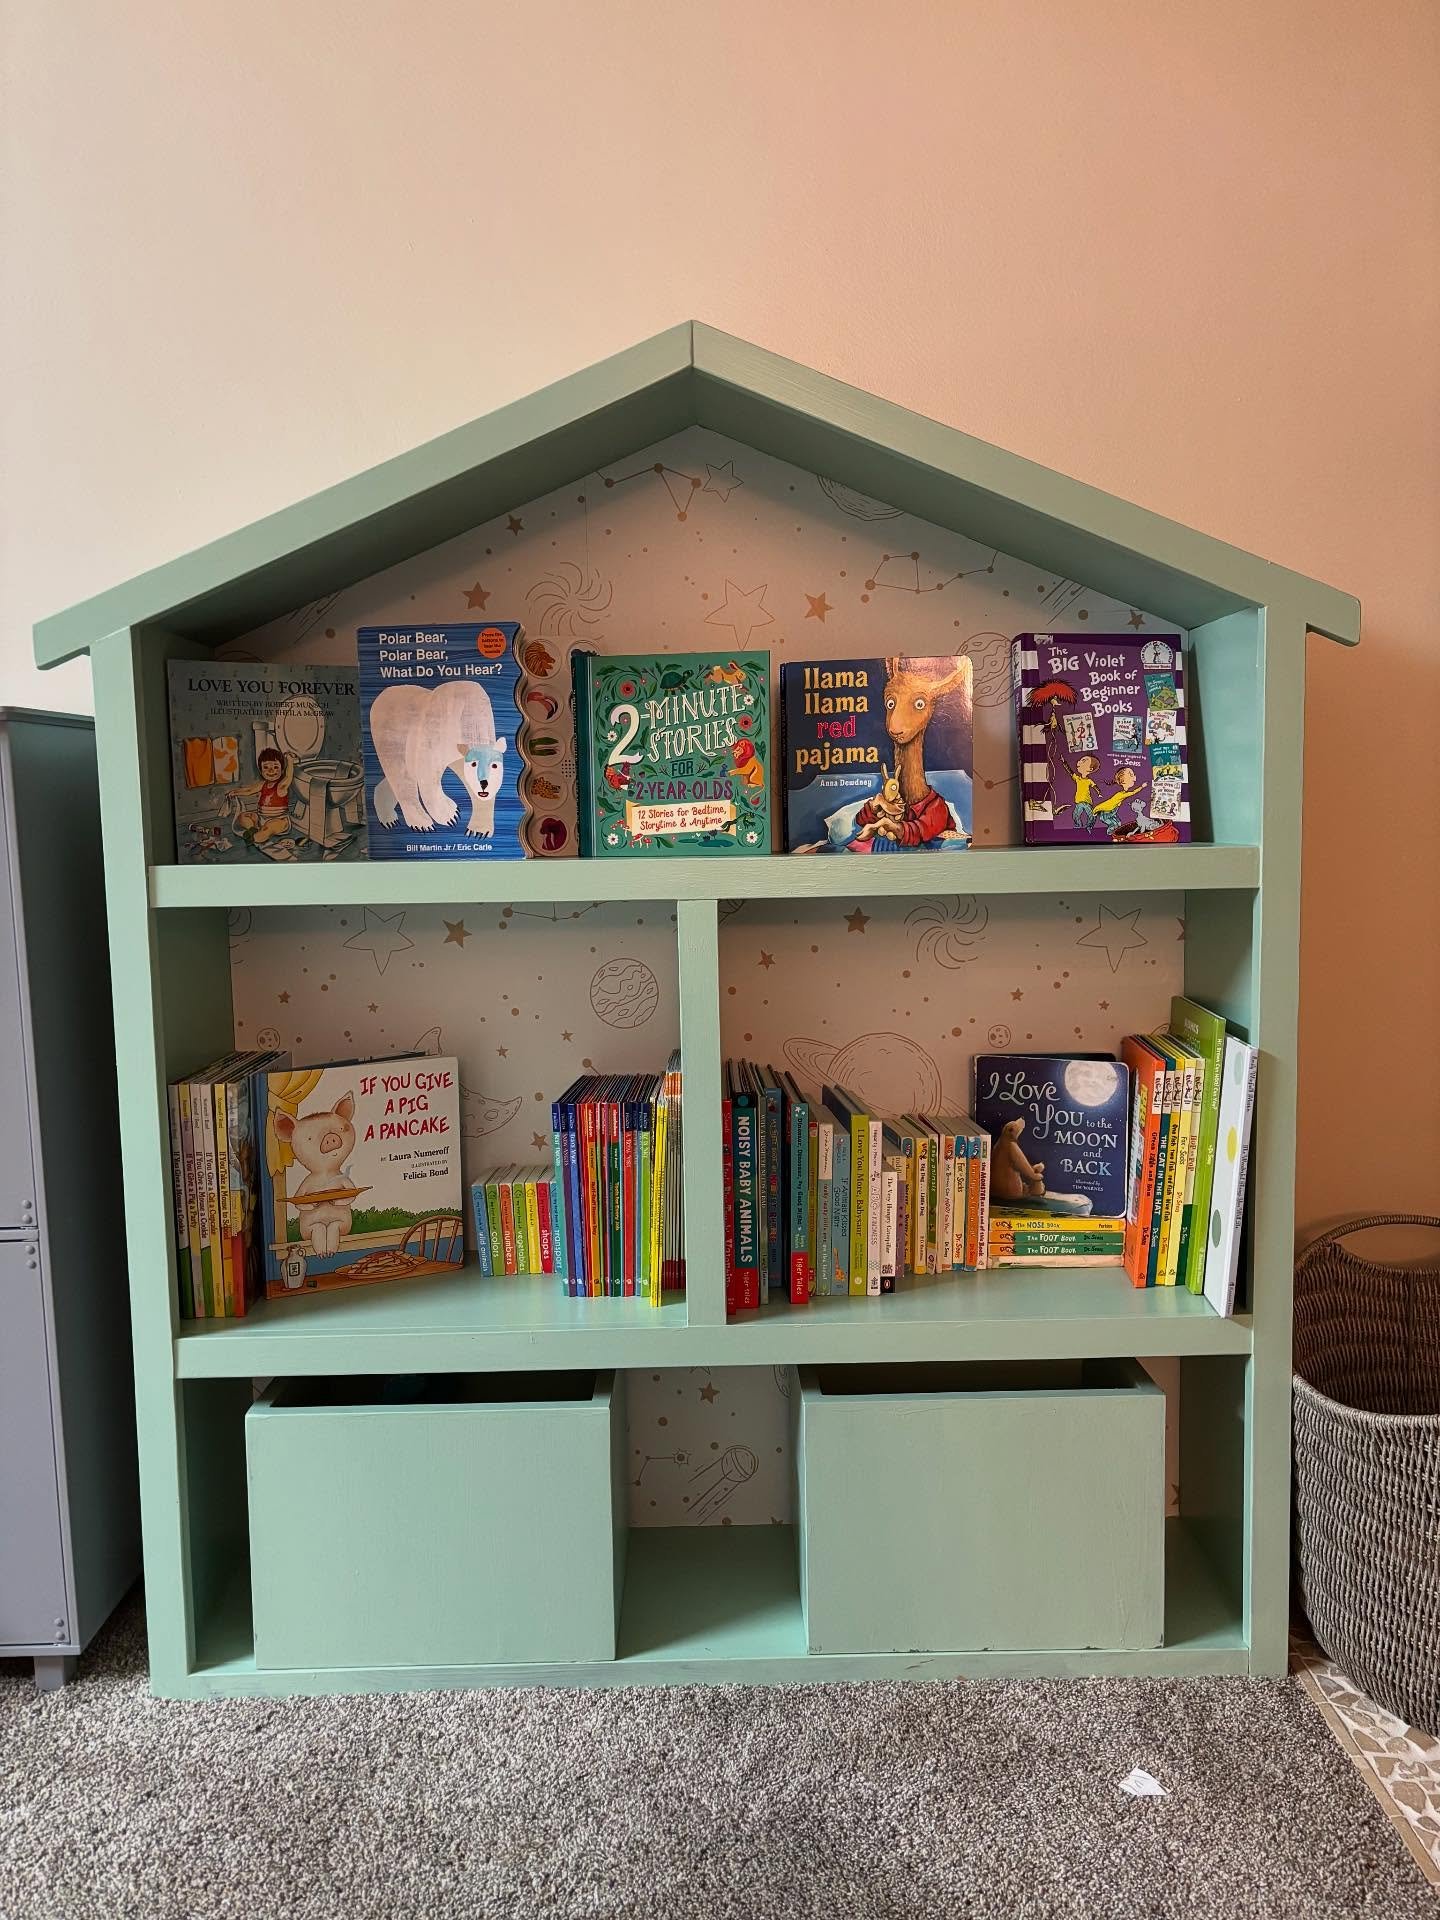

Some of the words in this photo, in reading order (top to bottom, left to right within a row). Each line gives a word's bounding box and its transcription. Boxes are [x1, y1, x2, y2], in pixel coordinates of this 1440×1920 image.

[379, 632, 412, 645] Polar
[415, 632, 448, 645] Bear,
[380, 650, 412, 662] Polar
[416, 649, 449, 662] Bear,
[1048, 647, 1068, 656] The
[1048, 656, 1080, 674] BIG
[1084, 651, 1126, 668] Violet
[380, 666, 412, 679] What
[416, 666, 434, 677] Do
[437, 665, 461, 676] You
[465, 663, 503, 675] Hear?
[803, 667, 869, 689] llama
[1089, 670, 1121, 685] Book
[1125, 670, 1138, 681] of
[188, 679, 232, 692] LOVE
[237, 680, 274, 693] YOU
[280, 681, 356, 696] FOREVER
[1080, 685, 1141, 703] Beginner
[804, 693, 869, 715] llama
[1091, 700, 1133, 717] Books
[816, 716, 857, 739] red
[1077, 726, 1086, 738] 2
[647, 717, 739, 762] STORIES
[1086, 737, 1095, 749] 3
[795, 742, 880, 774] pajama
[1124, 758, 1141, 767] Seuss
[671, 760, 694, 777] FOR
[635, 780, 734, 801] 2-YEAR-OLDS
[820, 779, 839, 787] Anna
[839, 779, 872, 788] Dewdney
[638, 810, 647, 819] 12
[648, 807, 674, 819] Stories
[677, 807, 689, 817] for
[691, 805, 727, 816] Bedtime,
[640, 819, 678, 832] Storytime
[679, 817, 687, 828] &
[690, 816, 722, 830] Anytime
[406, 844, 418, 852] Bill
[420, 844, 442, 852] Martin
[457, 843, 471, 851] Eric
[473, 843, 493, 851] Carle
[360, 1076, 377, 1096] IF
[381, 1072, 411, 1093] YOU
[415, 1071, 453, 1092] GIVE
[384, 1099, 394, 1116] A
[399, 1095, 428, 1115] PIG
[364, 1124, 375, 1142] A
[379, 1116, 450, 1139] PANCAKE
[1086, 1119, 1096, 1128] to
[1097, 1118, 1112, 1128] the
[738, 1116, 751, 1157] NOISY
[857, 1133, 865, 1154] Love
[1054, 1130, 1118, 1149] MOON
[1150, 1132, 1158, 1150] Green
[1170, 1135, 1179, 1147] fish
[389, 1152, 412, 1162] Laura
[414, 1146, 450, 1159] Numeroff
[1083, 1148, 1102, 1158] and
[1158, 1152, 1166, 1168] CAT
[1179, 1150, 1187, 1165] Socks
[196, 1157, 204, 1170] You
[206, 1159, 214, 1170] You
[219, 1157, 227, 1169] You
[857, 1156, 865, 1171] You
[957, 1163, 966, 1172] Fox
[1060, 1159, 1112, 1176] BACK
[1169, 1161, 1178, 1172] fish
[220, 1169, 228, 1184] Take
[403, 1172, 428, 1180] Felicia
[429, 1167, 449, 1177] Bond
[739, 1161, 752, 1195] BABY
[1157, 1170, 1164, 1179] IN
[1167, 1175, 1175, 1185] red
[855, 1173, 864, 1197] More,
[956, 1177, 965, 1192] Socks
[1155, 1181, 1163, 1196] THE
[1166, 1184, 1175, 1196] fish
[199, 1192, 207, 1211] Mouse
[220, 1190, 228, 1210] Mouse
[841, 1186, 849, 1213] Animals
[885, 1189, 893, 1202] Very
[1154, 1198, 1163, 1216] HAT
[1164, 1198, 1173, 1211] blue
[189, 1211, 197, 1229] Party
[885, 1203, 893, 1223] Hungry
[1163, 1211, 1172, 1222] fish
[200, 1218, 208, 1239] Cookie
[739, 1198, 753, 1263] ANIMALS
[841, 1214, 849, 1237] Kissed
[1027, 1221, 1045, 1229] NOSE
[491, 1231, 500, 1258] colors
[541, 1230, 550, 1259] shapes
[955, 1233, 963, 1243] Dr.
[1040, 1233, 1060, 1241] FOOT
[1150, 1235, 1158, 1248] Seuss
[504, 1231, 513, 1265] numbers
[517, 1230, 526, 1270] vegetables
[554, 1230, 563, 1269] transport
[954, 1243, 963, 1259] Seuss
[1040, 1246, 1060, 1254] FOOT
[480, 1247, 488, 1272] animals
